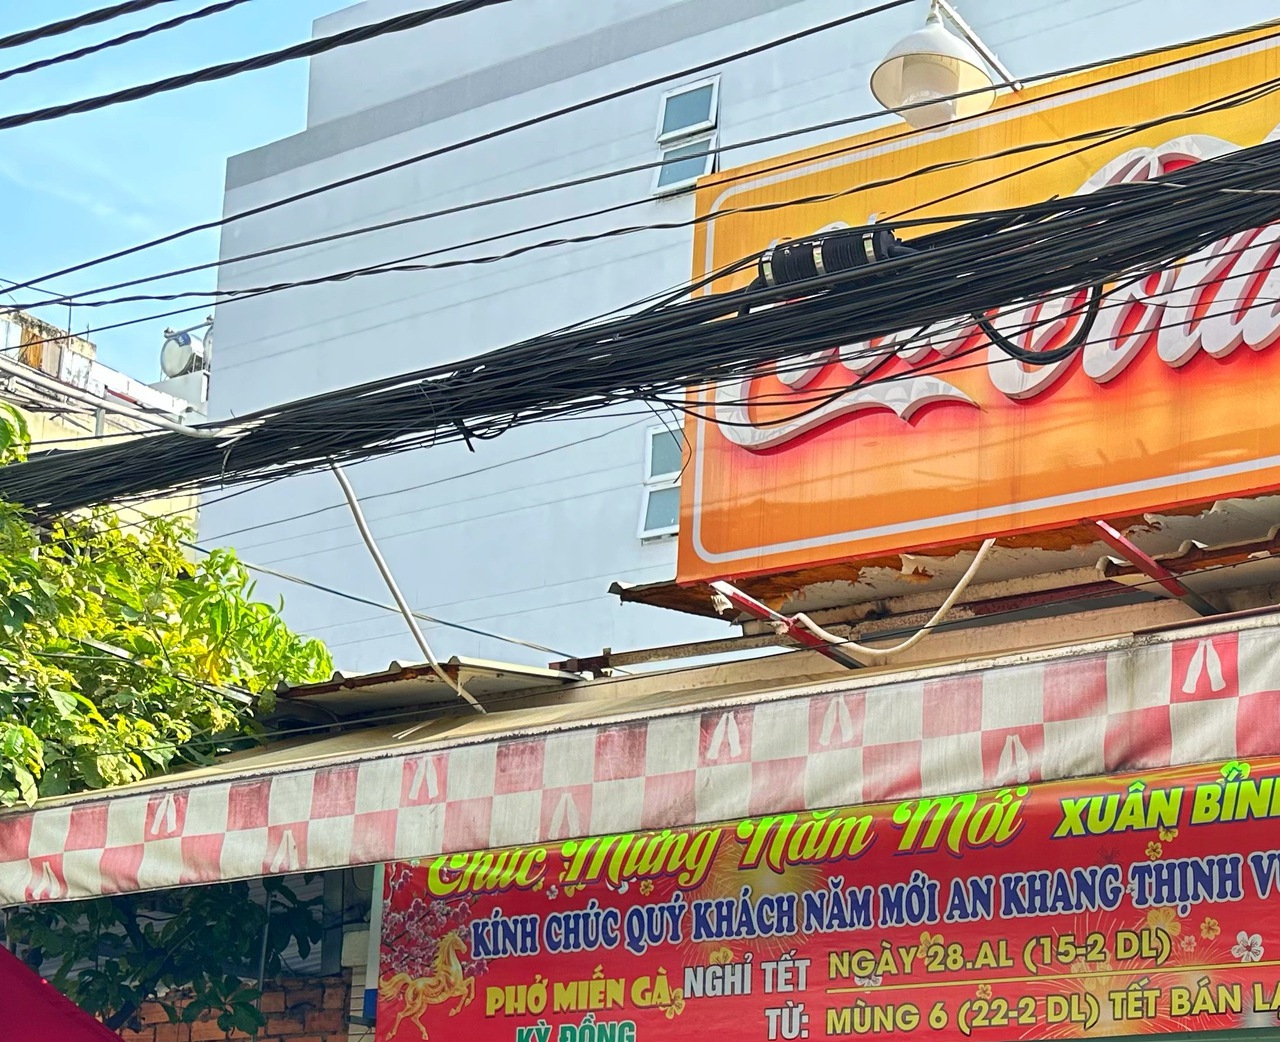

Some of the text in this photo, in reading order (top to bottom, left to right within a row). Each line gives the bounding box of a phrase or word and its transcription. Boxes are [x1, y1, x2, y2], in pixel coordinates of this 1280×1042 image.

[736, 808, 874, 870] Năm
[893, 786, 1029, 855] Mới
[1053, 781, 1184, 838] XUÂN
[472, 907, 539, 957] KÍNH
[545, 900, 621, 951] CHÚC
[626, 892, 686, 955] QUÝ
[692, 886, 797, 936] KHÁCH
[804, 876, 873, 932] NĂM
[880, 871, 939, 926] MỚI
[946, 876, 993, 921] AN
[1001, 865, 1123, 919] KHANG
[1132, 854, 1243, 916] THỊNH
[684, 949, 811, 999] NGHỈ TẾT
[828, 928, 1172, 980] NGÀY 28.AL (15-2 DL)
[485, 964, 672, 1017] PHỞ MIẾN GÀ
[825, 998, 920, 1036] MÙNG
[928, 1001, 949, 1031] 6
[958, 998, 1037, 1037] (22-2
[1047, 993, 1101, 1031] DL)
[1109, 976, 1162, 1020] TẾT
[1169, 977, 1242, 1017] BÁN
[764, 999, 810, 1041] TỪ:
